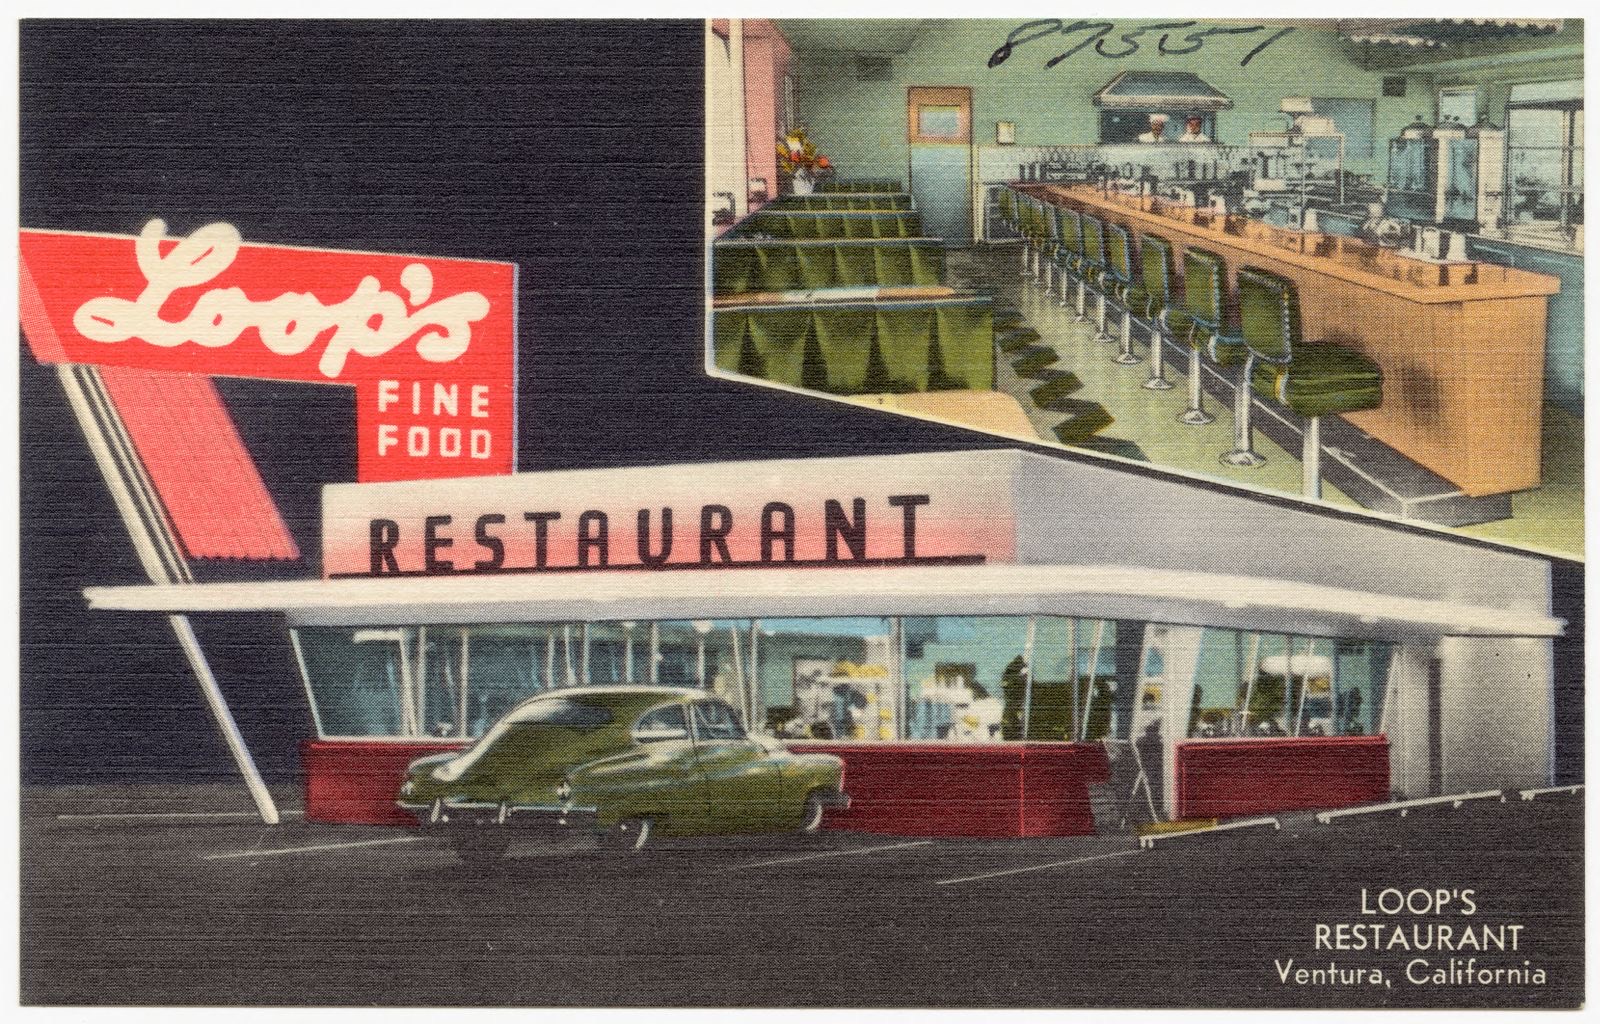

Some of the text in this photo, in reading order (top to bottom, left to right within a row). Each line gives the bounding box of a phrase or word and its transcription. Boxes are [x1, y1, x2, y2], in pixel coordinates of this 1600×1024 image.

[73, 218, 491, 378] Loop's
[377, 379, 490, 418] FINE
[377, 424, 493, 460] FOOD
[369, 494, 930, 574] RESTAURANT
